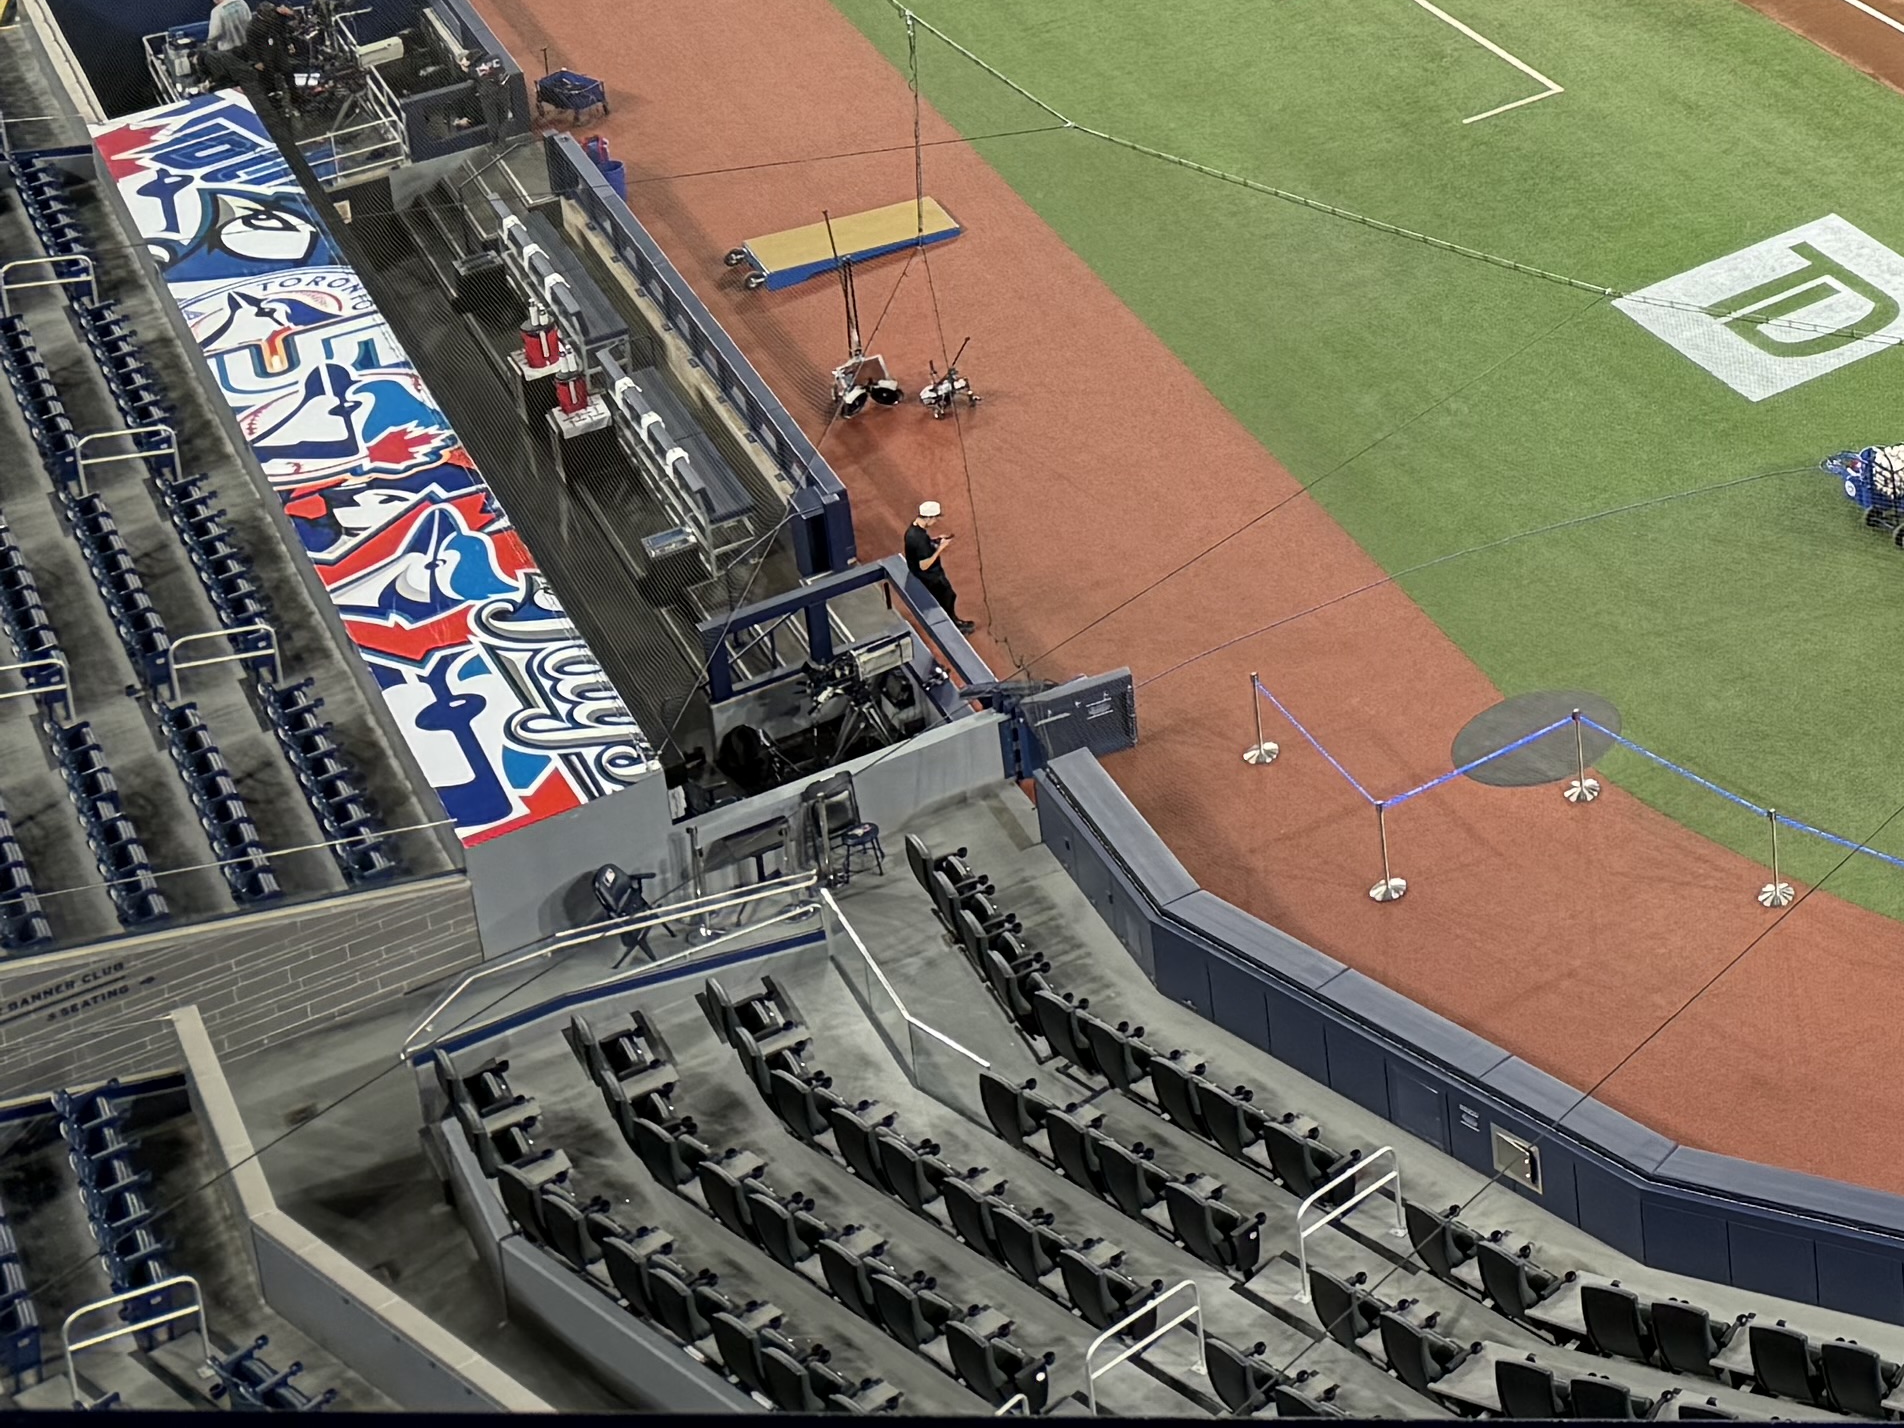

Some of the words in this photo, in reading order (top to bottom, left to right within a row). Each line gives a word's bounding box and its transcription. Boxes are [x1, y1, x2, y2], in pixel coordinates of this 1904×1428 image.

[1699, 241, 1900, 357] TD
[8, 980, 75, 1012] BANNER
[60, 985, 130, 1016] SEATING
